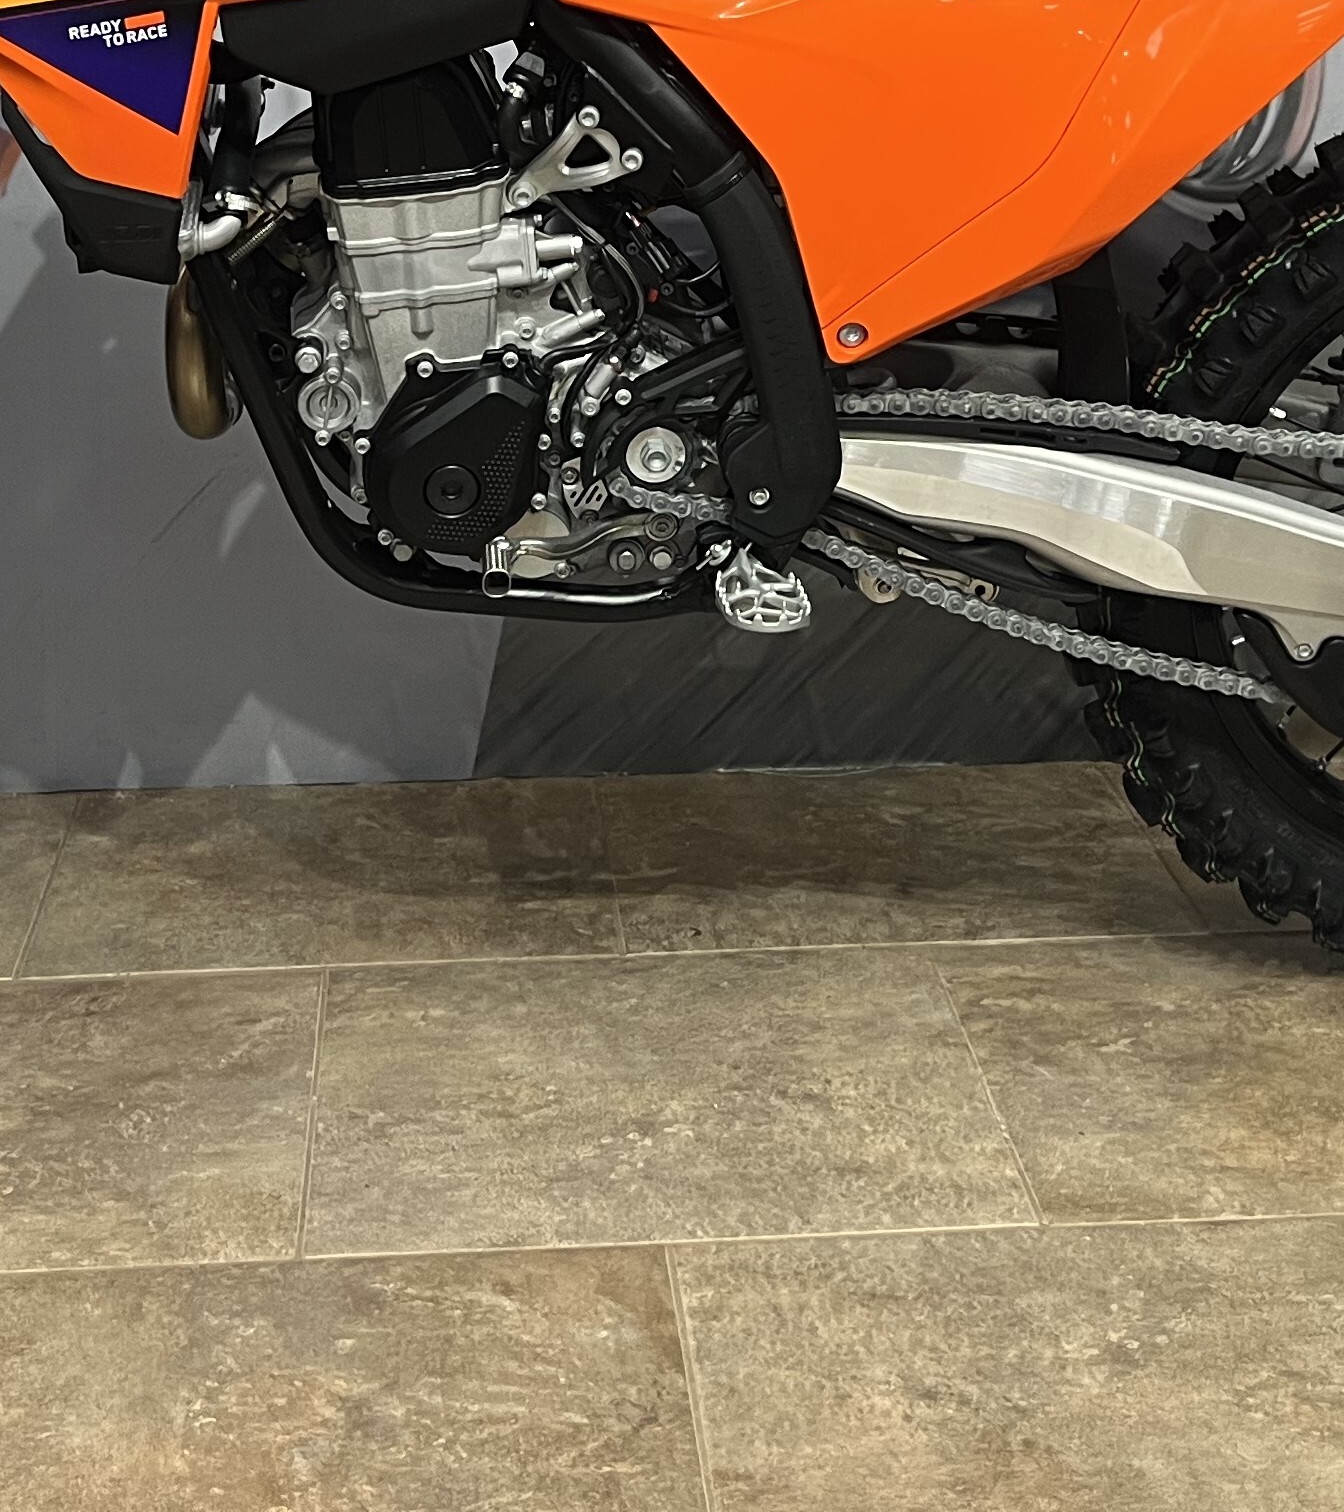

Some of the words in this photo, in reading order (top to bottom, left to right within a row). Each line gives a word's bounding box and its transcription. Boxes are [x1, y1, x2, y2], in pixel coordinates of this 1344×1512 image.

[68, 19, 121, 40] READY
[102, 33, 125, 48] TO
[126, 24, 168, 44] RACE
